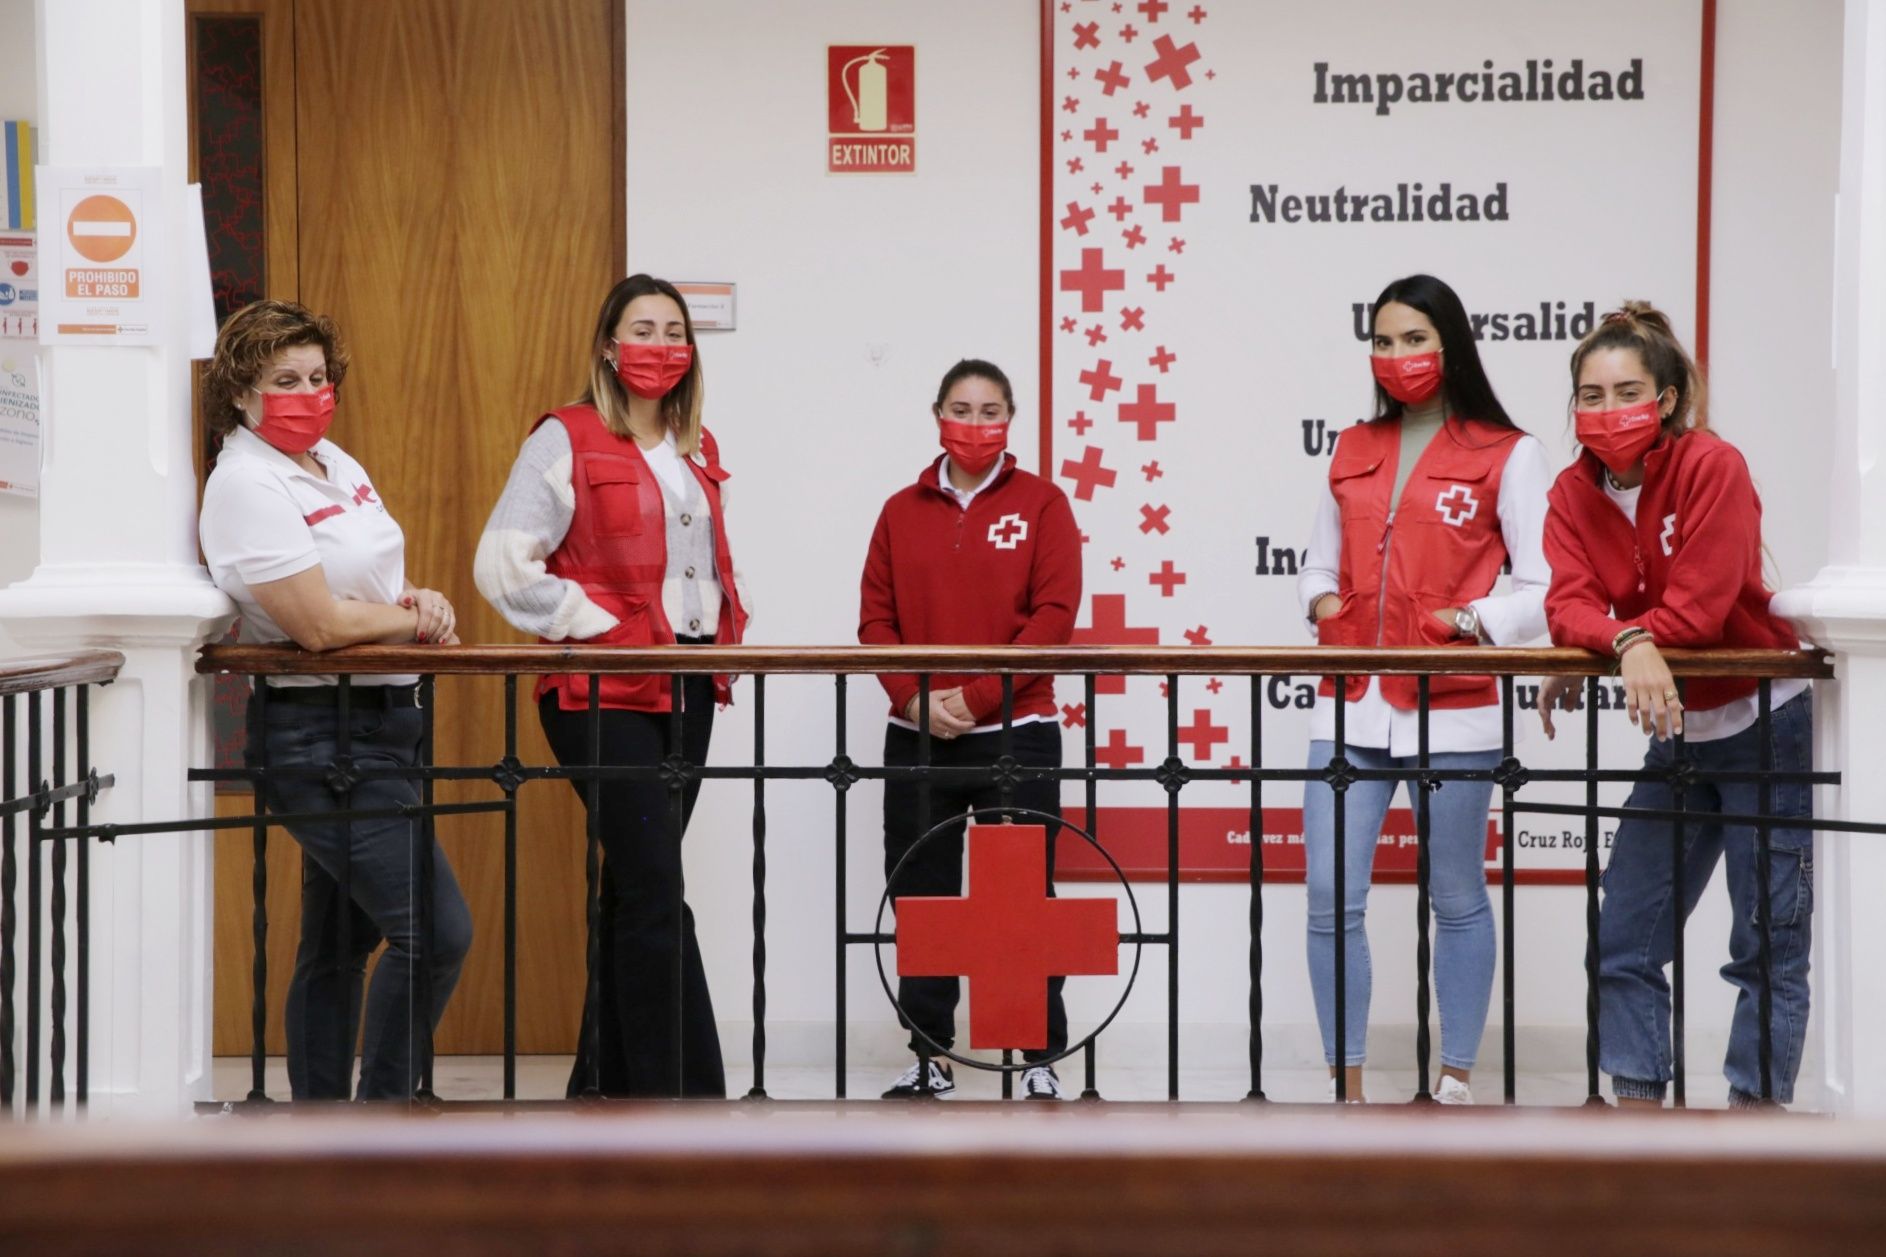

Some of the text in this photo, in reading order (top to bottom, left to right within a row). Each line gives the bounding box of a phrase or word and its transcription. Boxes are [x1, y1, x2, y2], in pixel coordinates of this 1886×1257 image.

[1314, 59, 1644, 115] Imparcialidad
[833, 144, 910, 165] EXTINTOR
[1251, 183, 1508, 222] Neutralidad
[68, 271, 137, 283] PROHIBIDO
[77, 284, 128, 296] EL PASO
[1227, 830, 1252, 844] Cad
[1262, 834, 1284, 844] vez
[1287, 832, 1305, 844] má
[1517, 830, 1557, 848] Cruz
